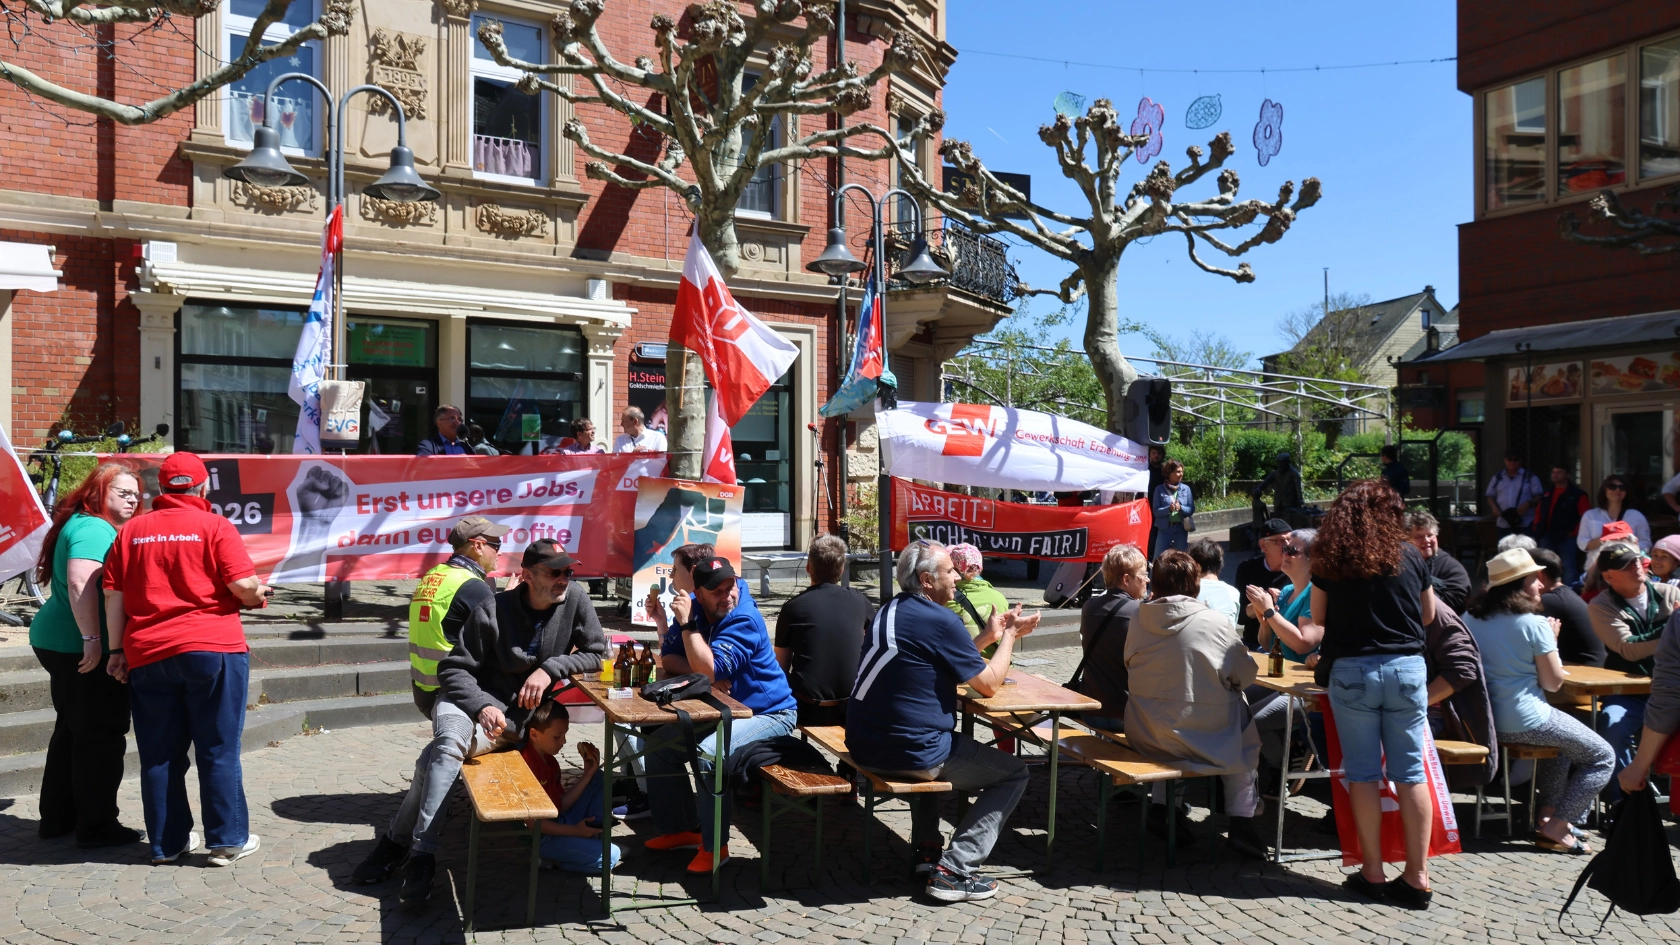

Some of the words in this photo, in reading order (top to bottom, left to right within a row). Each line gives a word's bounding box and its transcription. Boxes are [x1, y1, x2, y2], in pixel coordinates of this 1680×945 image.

[384, 70, 417, 87] 1895
[629, 371, 665, 383] H.Stein
[327, 418, 358, 433] EVG
[924, 418, 997, 438] GEW
[1015, 429, 1085, 449] Gewerkschaft
[1090, 440, 1131, 462] Erziehung
[356, 491, 410, 515] Erst
[417, 487, 512, 511] unsere
[518, 480, 585, 500] Jobs,
[911, 490, 988, 523] ARBEIT:
[211, 501, 262, 525] 26
[132, 535, 156, 545] Stark
[157, 534, 167, 542] in
[168, 533, 202, 542] Arbeit.
[337, 530, 410, 548] dann
[417, 528, 451, 544] eu
[502, 522, 572, 545] rofite
[1029, 532, 1080, 555] FAIR!
[655, 566, 674, 575] Ers
